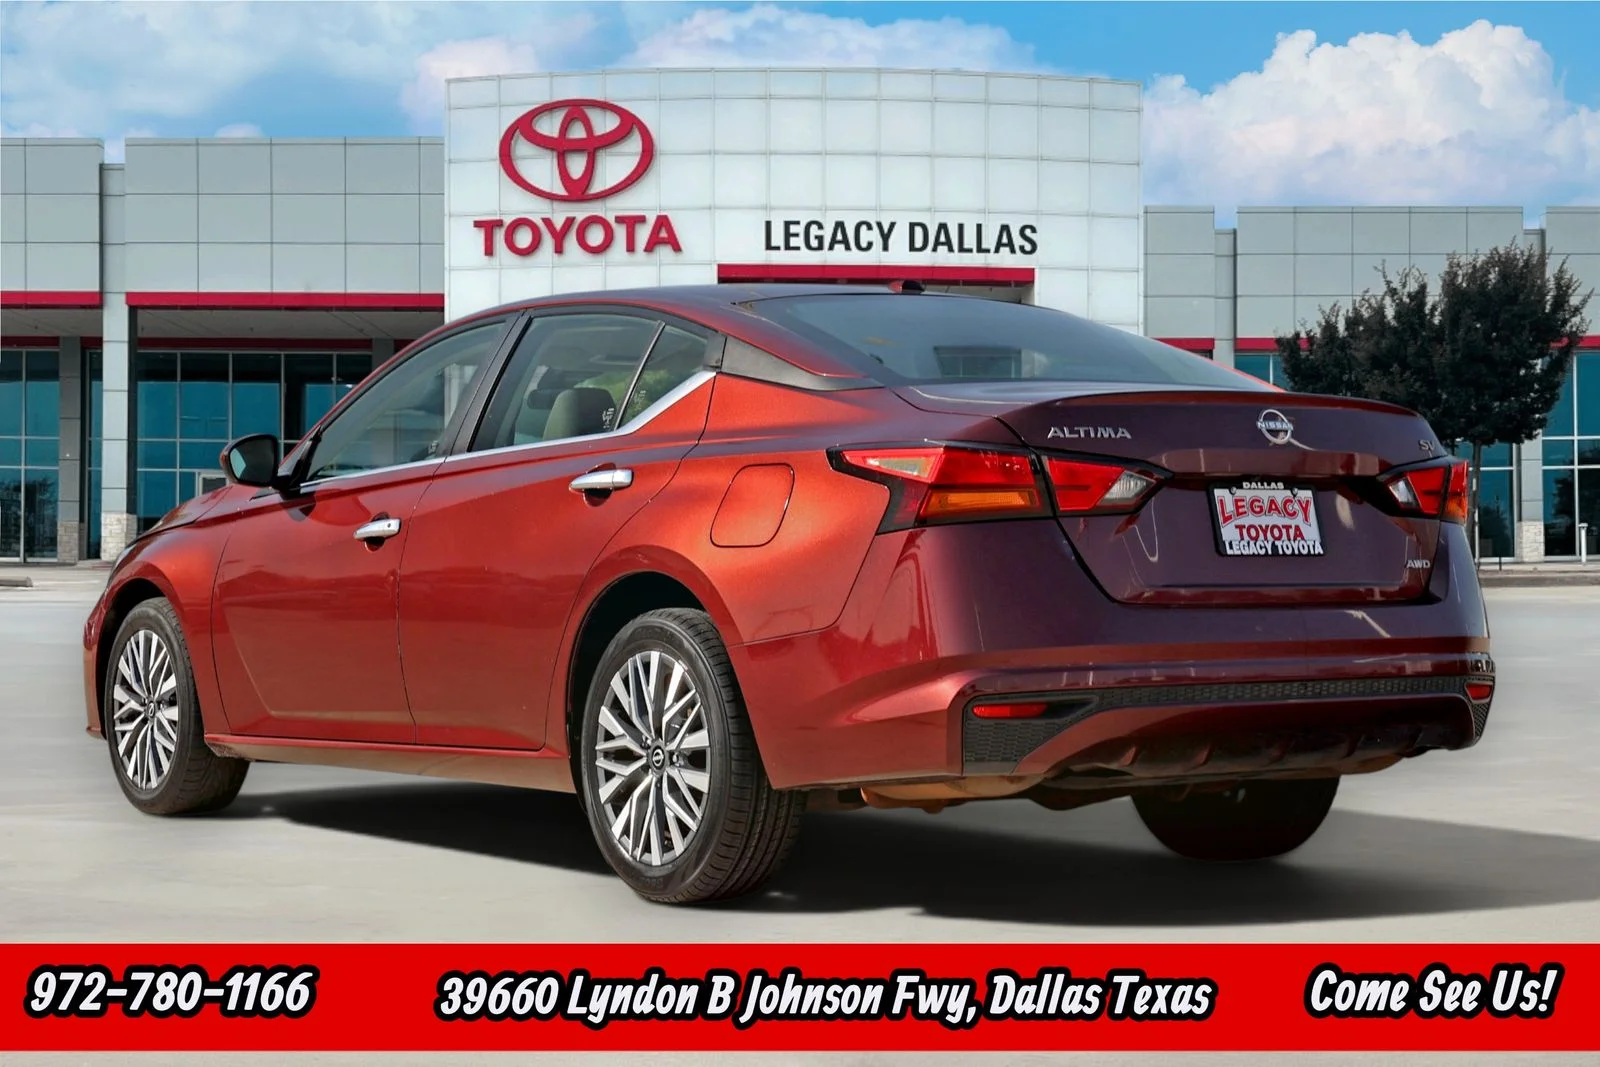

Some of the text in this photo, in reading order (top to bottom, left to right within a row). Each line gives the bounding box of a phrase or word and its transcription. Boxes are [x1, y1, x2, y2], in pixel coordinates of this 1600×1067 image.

[474, 214, 682, 257] TOYOTA
[765, 220, 1038, 255] LEGACY DALLAS
[1047, 426, 1132, 439] ALTIMA
[1257, 420, 1294, 431] NISSAN
[1242, 481, 1285, 490] DALLAS
[1217, 495, 1314, 527] LEGACY
[1234, 524, 1306, 541] TOYOTA
[1224, 540, 1325, 555] LEGACY TOYOTA
[1406, 560, 1431, 568] AWD
